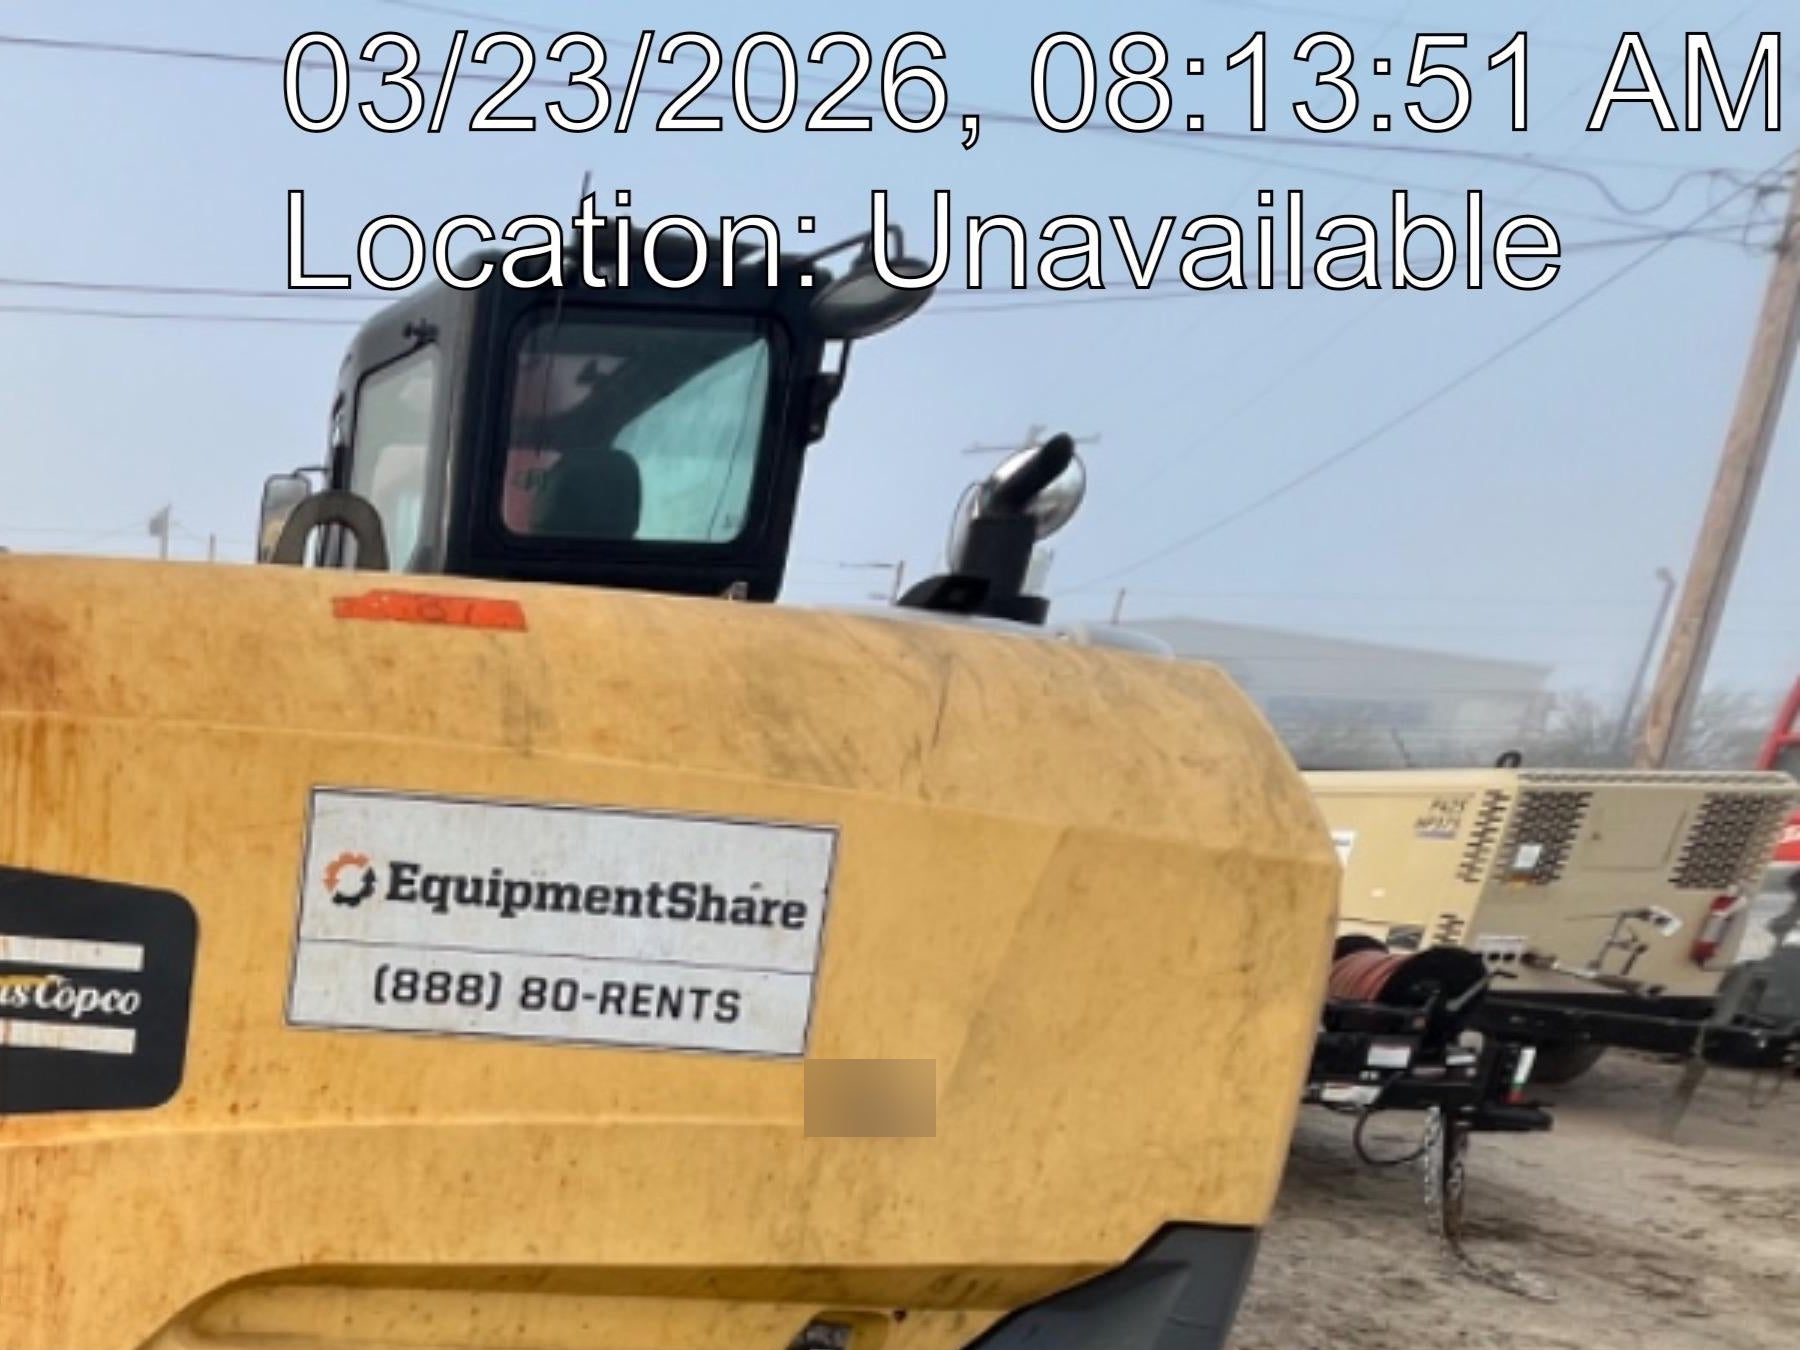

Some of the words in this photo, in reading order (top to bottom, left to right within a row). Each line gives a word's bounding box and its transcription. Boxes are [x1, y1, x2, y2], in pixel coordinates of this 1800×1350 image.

[384, 861, 807, 931] EquipmentShare
[34, 974, 141, 1019] Copco
[373, 963, 501, 1012] (888)
[519, 977, 741, 1023] 80-RENTS
